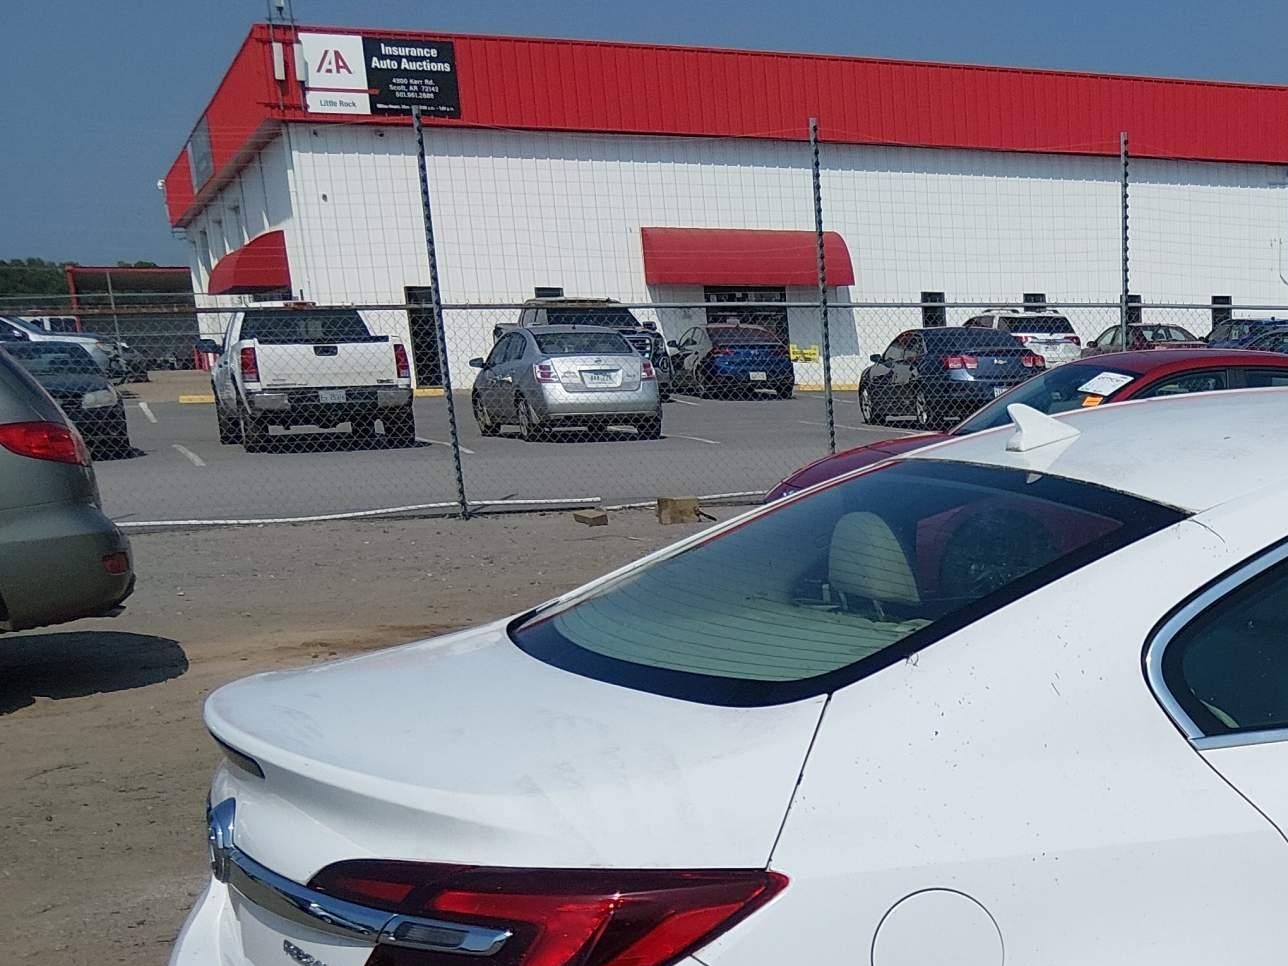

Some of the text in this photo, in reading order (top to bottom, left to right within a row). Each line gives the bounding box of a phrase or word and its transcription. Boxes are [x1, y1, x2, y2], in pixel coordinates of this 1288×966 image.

[380, 42, 438, 57] Insurance
[371, 56, 451, 72] Auto Auctions
[319, 99, 357, 108] Little Rock
